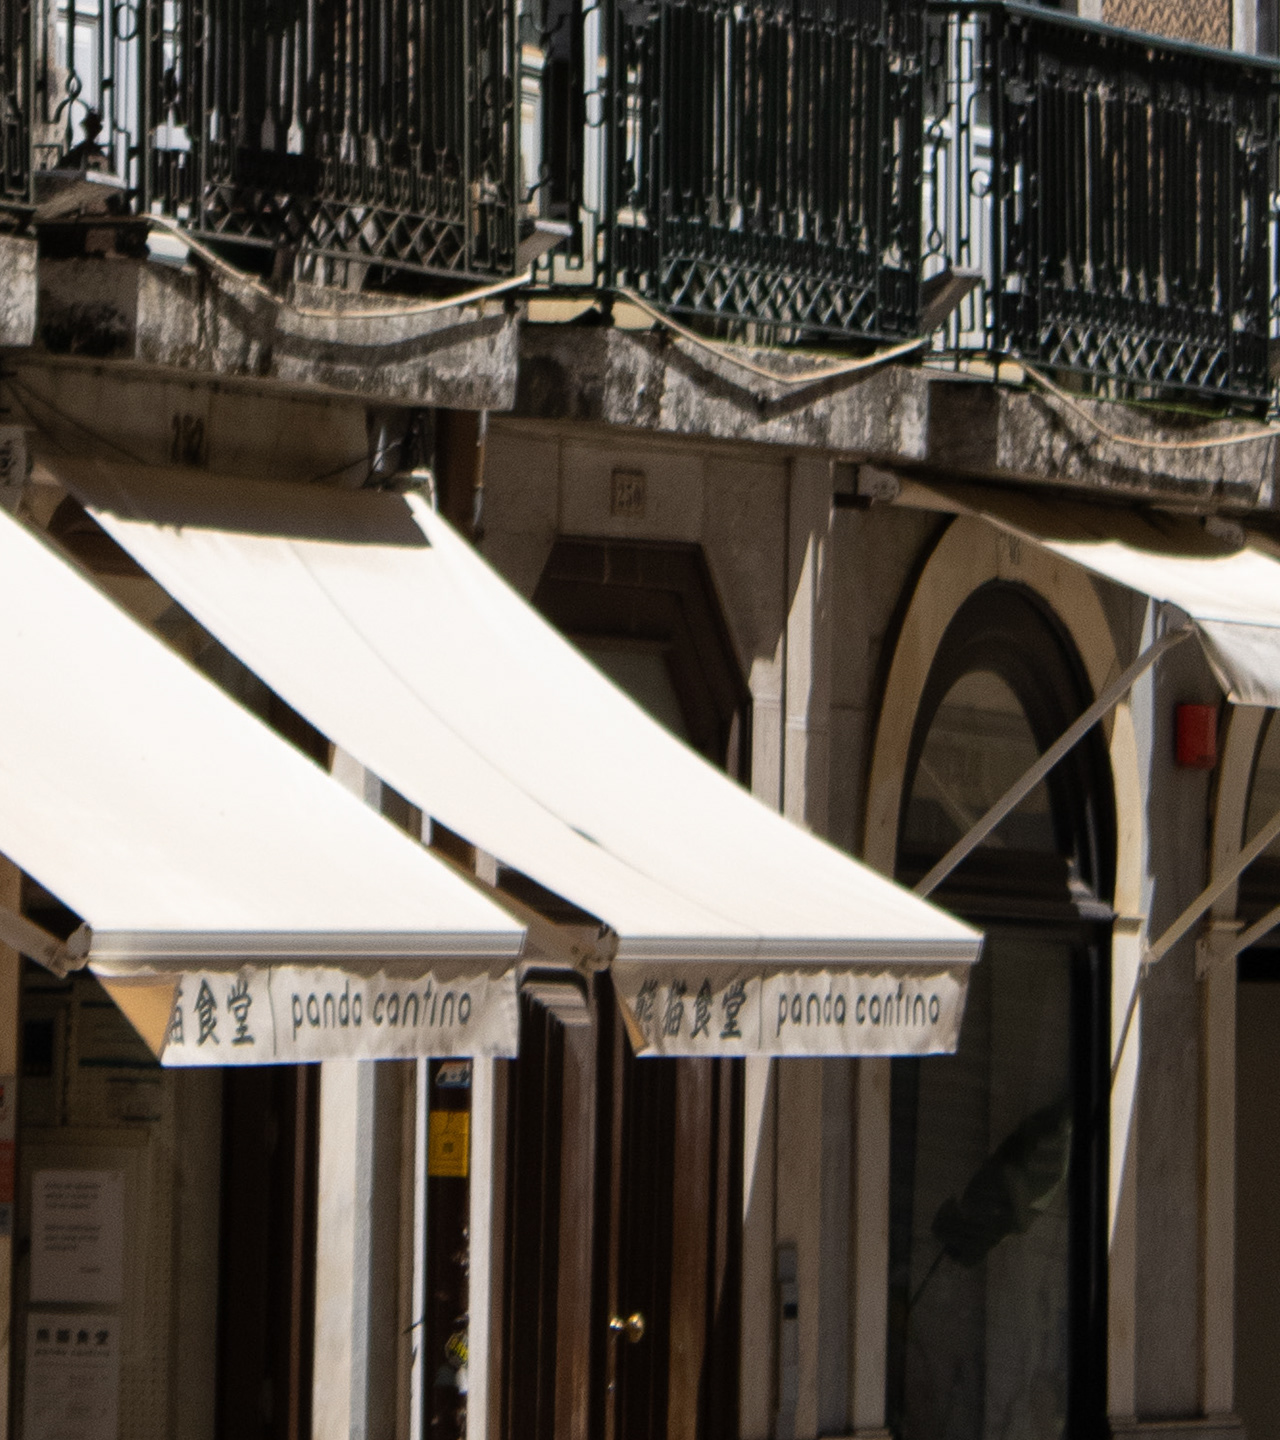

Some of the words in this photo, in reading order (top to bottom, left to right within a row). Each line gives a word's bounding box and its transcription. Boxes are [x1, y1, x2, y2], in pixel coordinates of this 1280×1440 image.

[291, 979, 363, 1042] panda
[373, 979, 471, 1028] cantina
[776, 982, 847, 1039] panda
[855, 981, 941, 1028] cantina
